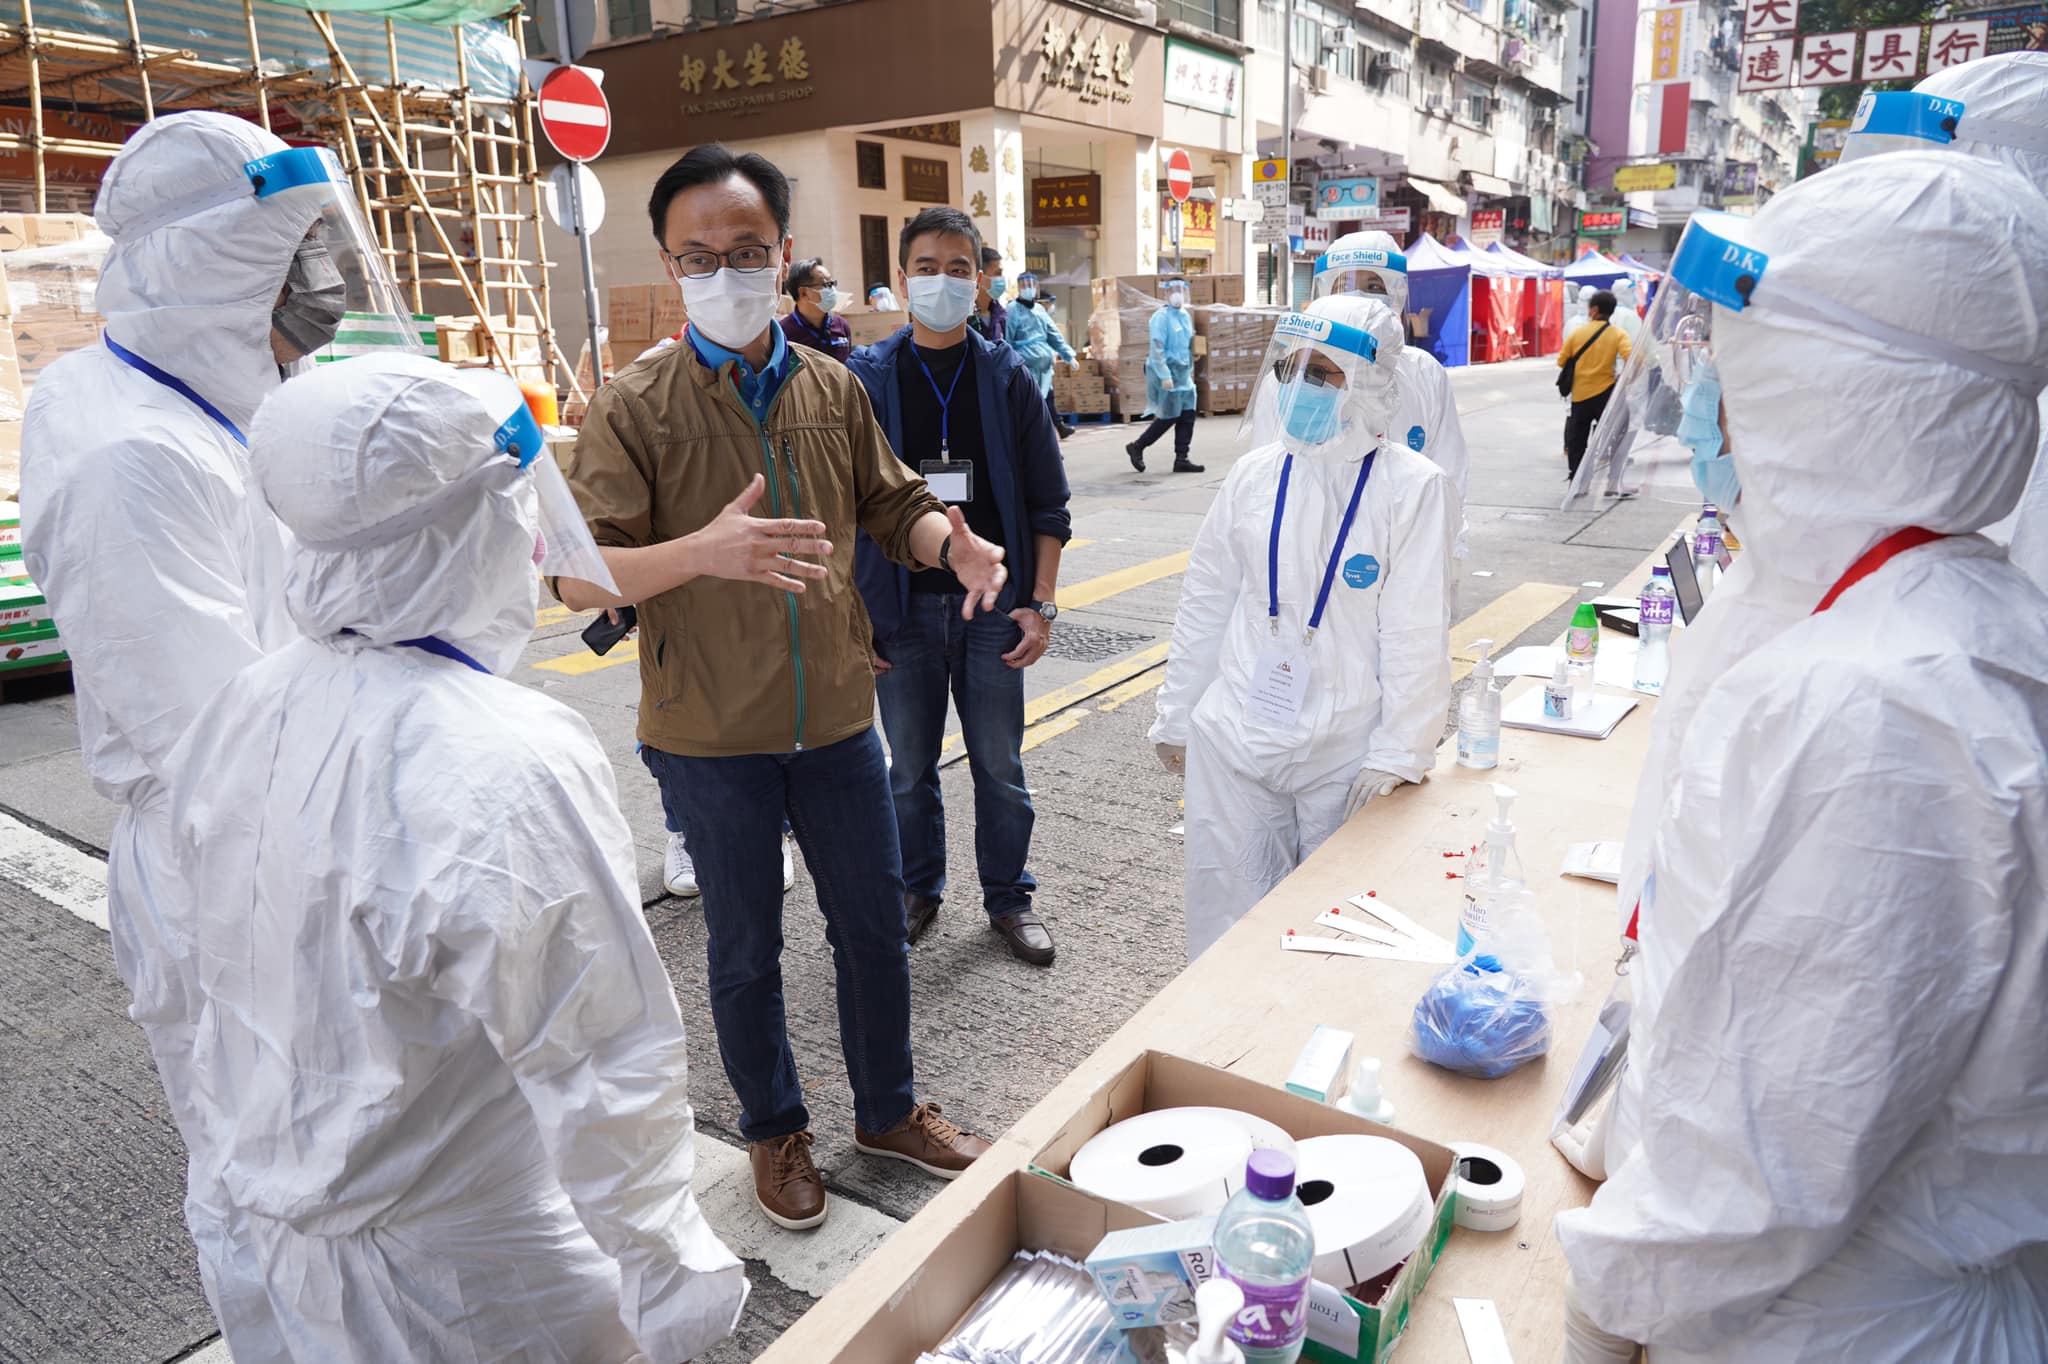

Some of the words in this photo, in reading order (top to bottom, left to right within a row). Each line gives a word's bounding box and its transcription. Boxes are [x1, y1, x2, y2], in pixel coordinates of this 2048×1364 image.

[1746, 28, 1979, 83] 達文具行
[779, 86, 814, 101] SHOP
[1928, 98, 1960, 117] D.K.
[247, 158, 275, 175] D.K.
[1331, 253, 1351, 263] Face
[1353, 250, 1383, 262] Shield
[1722, 244, 1761, 274] D.K.
[1288, 314, 1324, 332] Shield
[1643, 602, 1671, 618] vita
[1187, 1252, 1210, 1284] Rol
